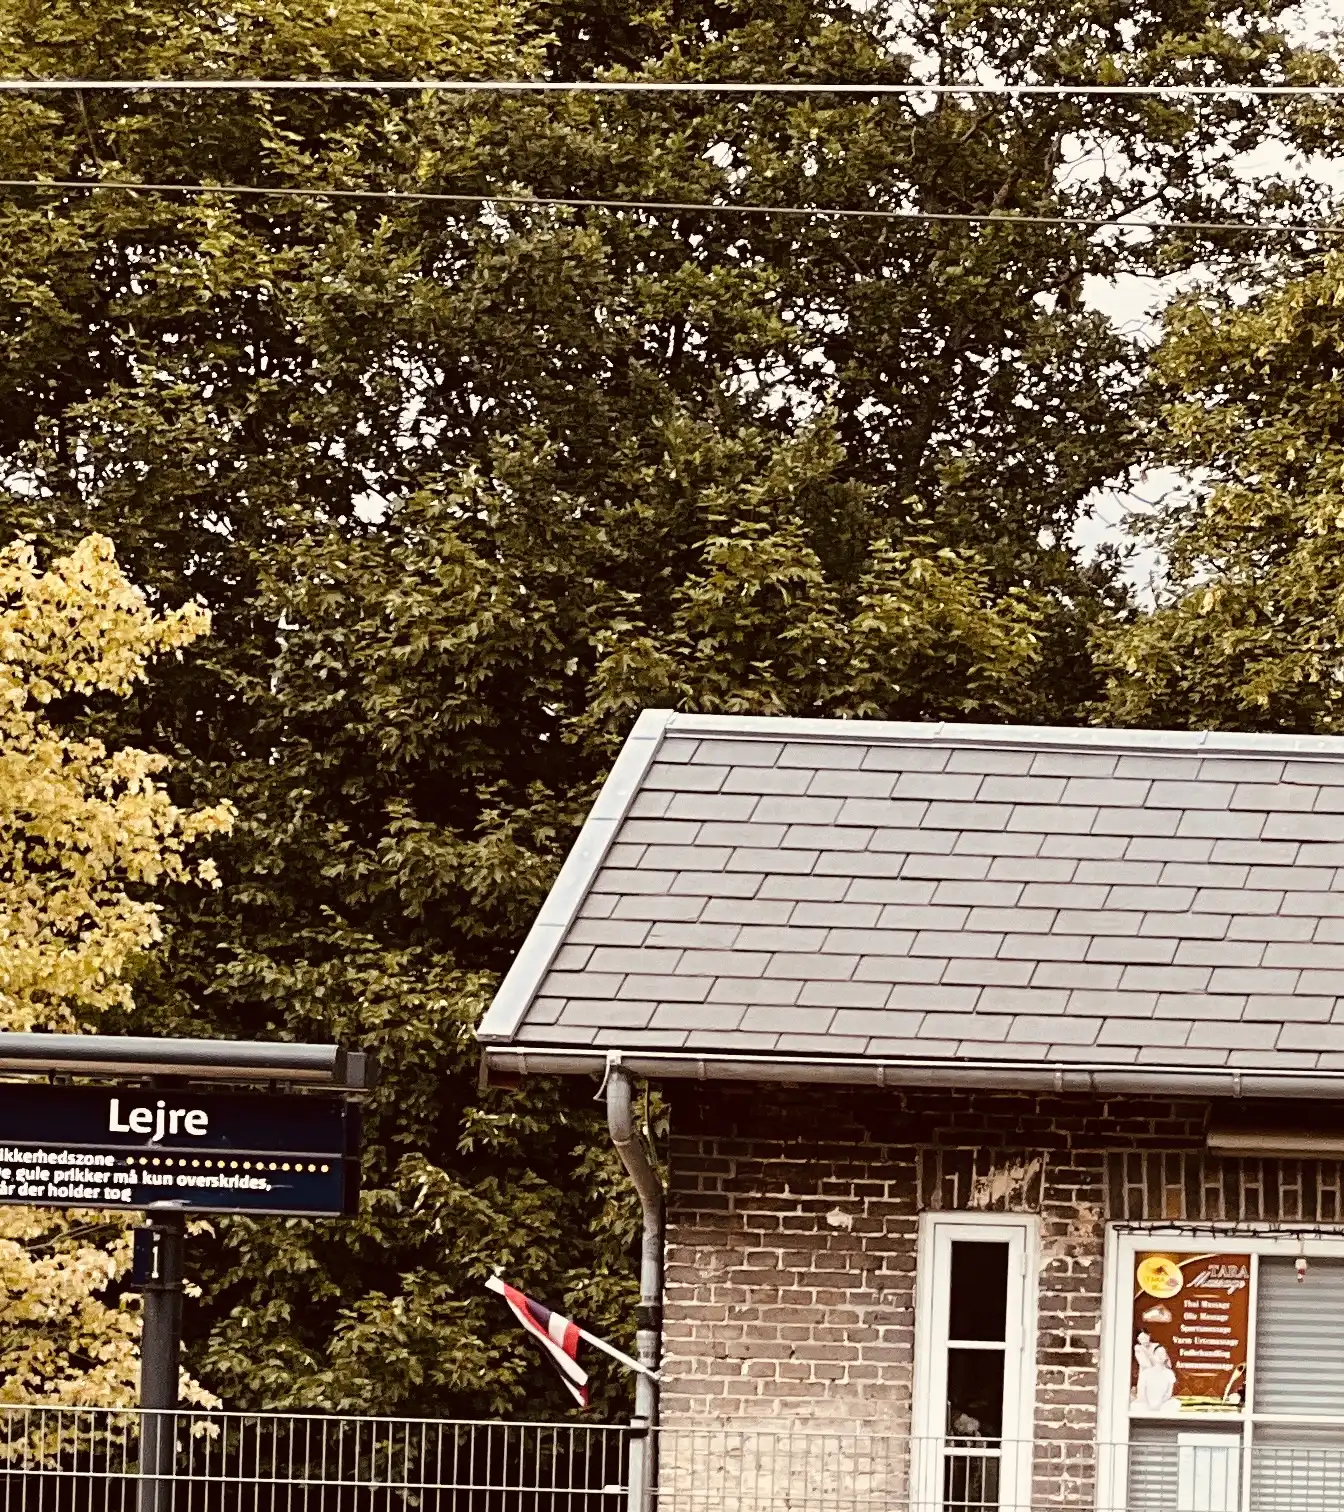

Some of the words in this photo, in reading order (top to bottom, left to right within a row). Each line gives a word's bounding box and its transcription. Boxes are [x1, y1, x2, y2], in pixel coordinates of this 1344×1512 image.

[109, 1098, 208, 1141] Lejre
[16, 1166, 50, 1183] gule
[54, 1168, 110, 1184] prikker
[113, 1169, 138, 1184] må
[142, 1170, 173, 1185] kun
[177, 1173, 271, 1191] overskrides,
[18, 1182, 45, 1197] der
[48, 1183, 100, 1198] holder
[104, 1187, 132, 1202] tog
[1208, 1264, 1249, 1278] TARA
